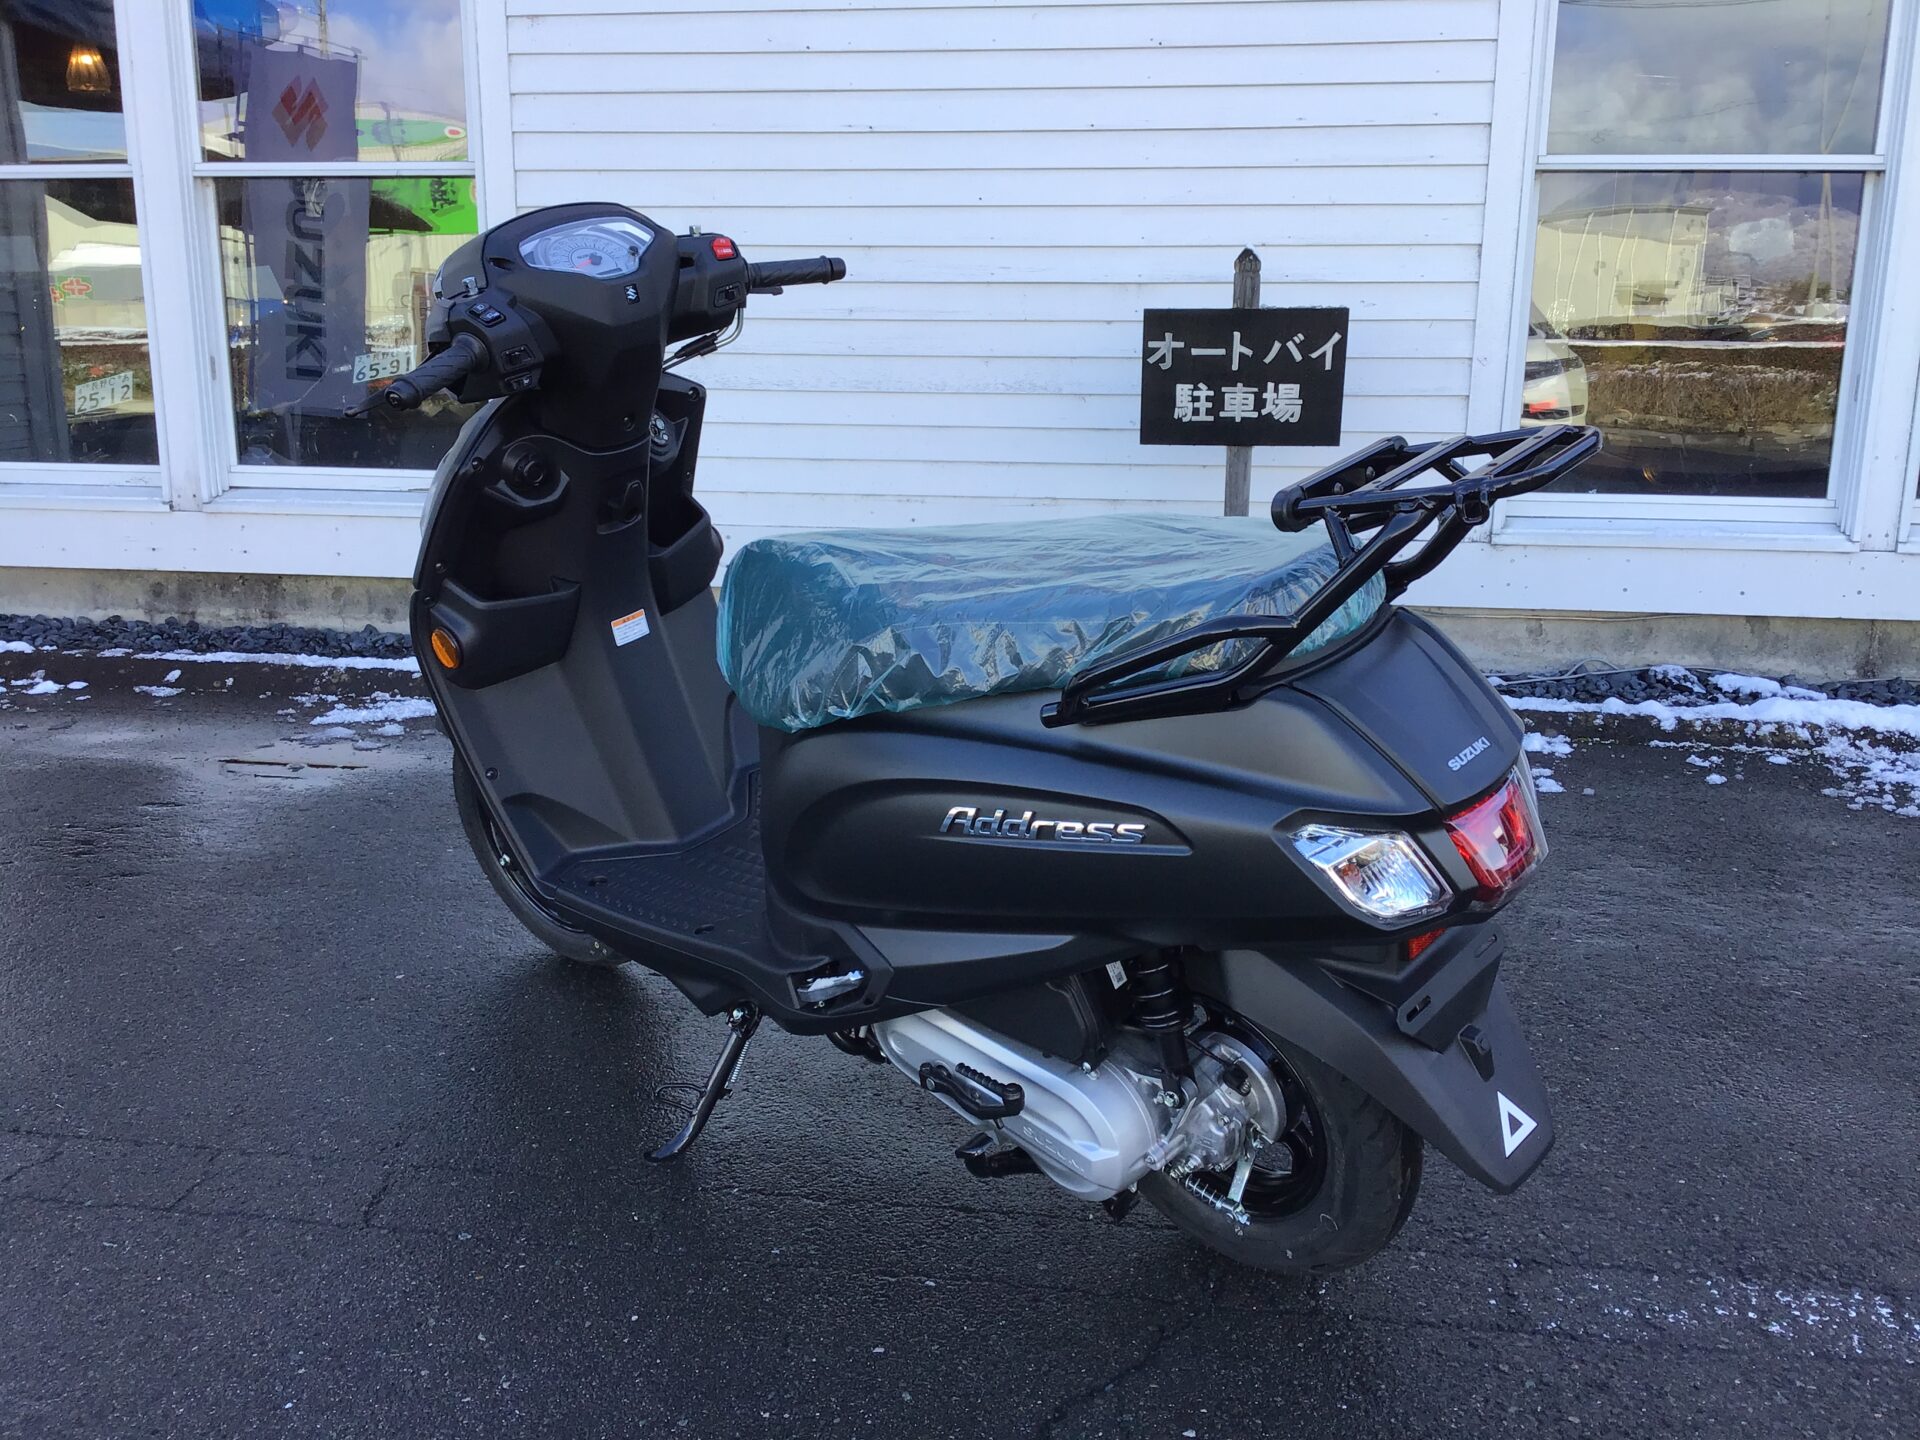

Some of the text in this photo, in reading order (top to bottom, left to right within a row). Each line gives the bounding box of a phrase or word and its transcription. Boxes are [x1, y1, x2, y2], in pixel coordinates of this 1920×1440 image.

[355, 356, 411, 382] 65-91
[1146, 330, 1343, 371] オートバイ
[77, 384, 131, 413] 25-12
[1173, 381, 1303, 424] 駐車場
[1447, 735, 1491, 772] SUZUKI
[939, 806, 1148, 844] Address
